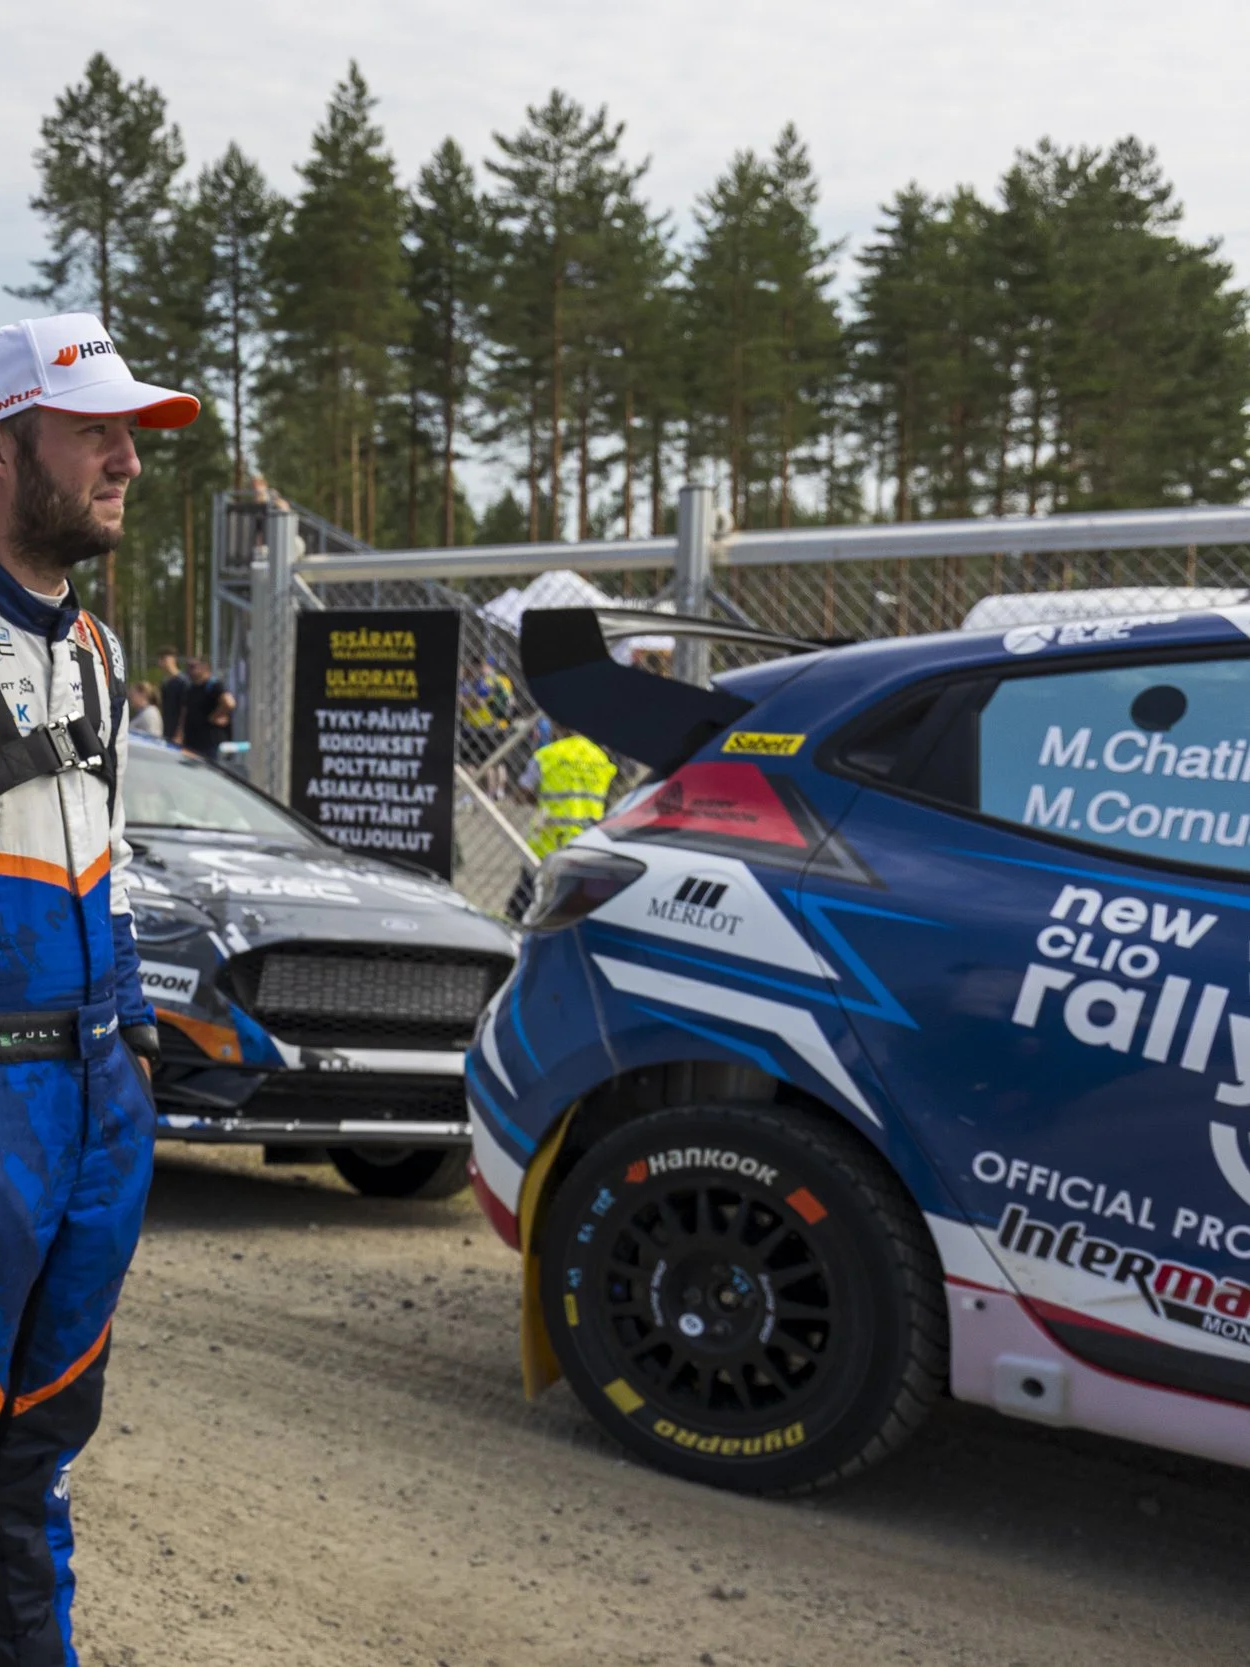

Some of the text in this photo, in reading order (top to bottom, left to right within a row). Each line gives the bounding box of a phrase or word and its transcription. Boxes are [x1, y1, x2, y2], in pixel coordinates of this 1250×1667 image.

[315, 707, 433, 732] TYKY-PÄIVÄT
[319, 733, 428, 756] KOKOUKSET
[323, 757, 422, 779] POLTTARIT
[306, 777, 438, 805] ASIAKASILLAT
[319, 802, 424, 827] SYNTTÄRIT
[647, 897, 744, 936] MERLOT
[1049, 884, 1219, 949] new
[1037, 925, 1160, 979] CLIO
[972, 1151, 1156, 1231] OFFICIAL
